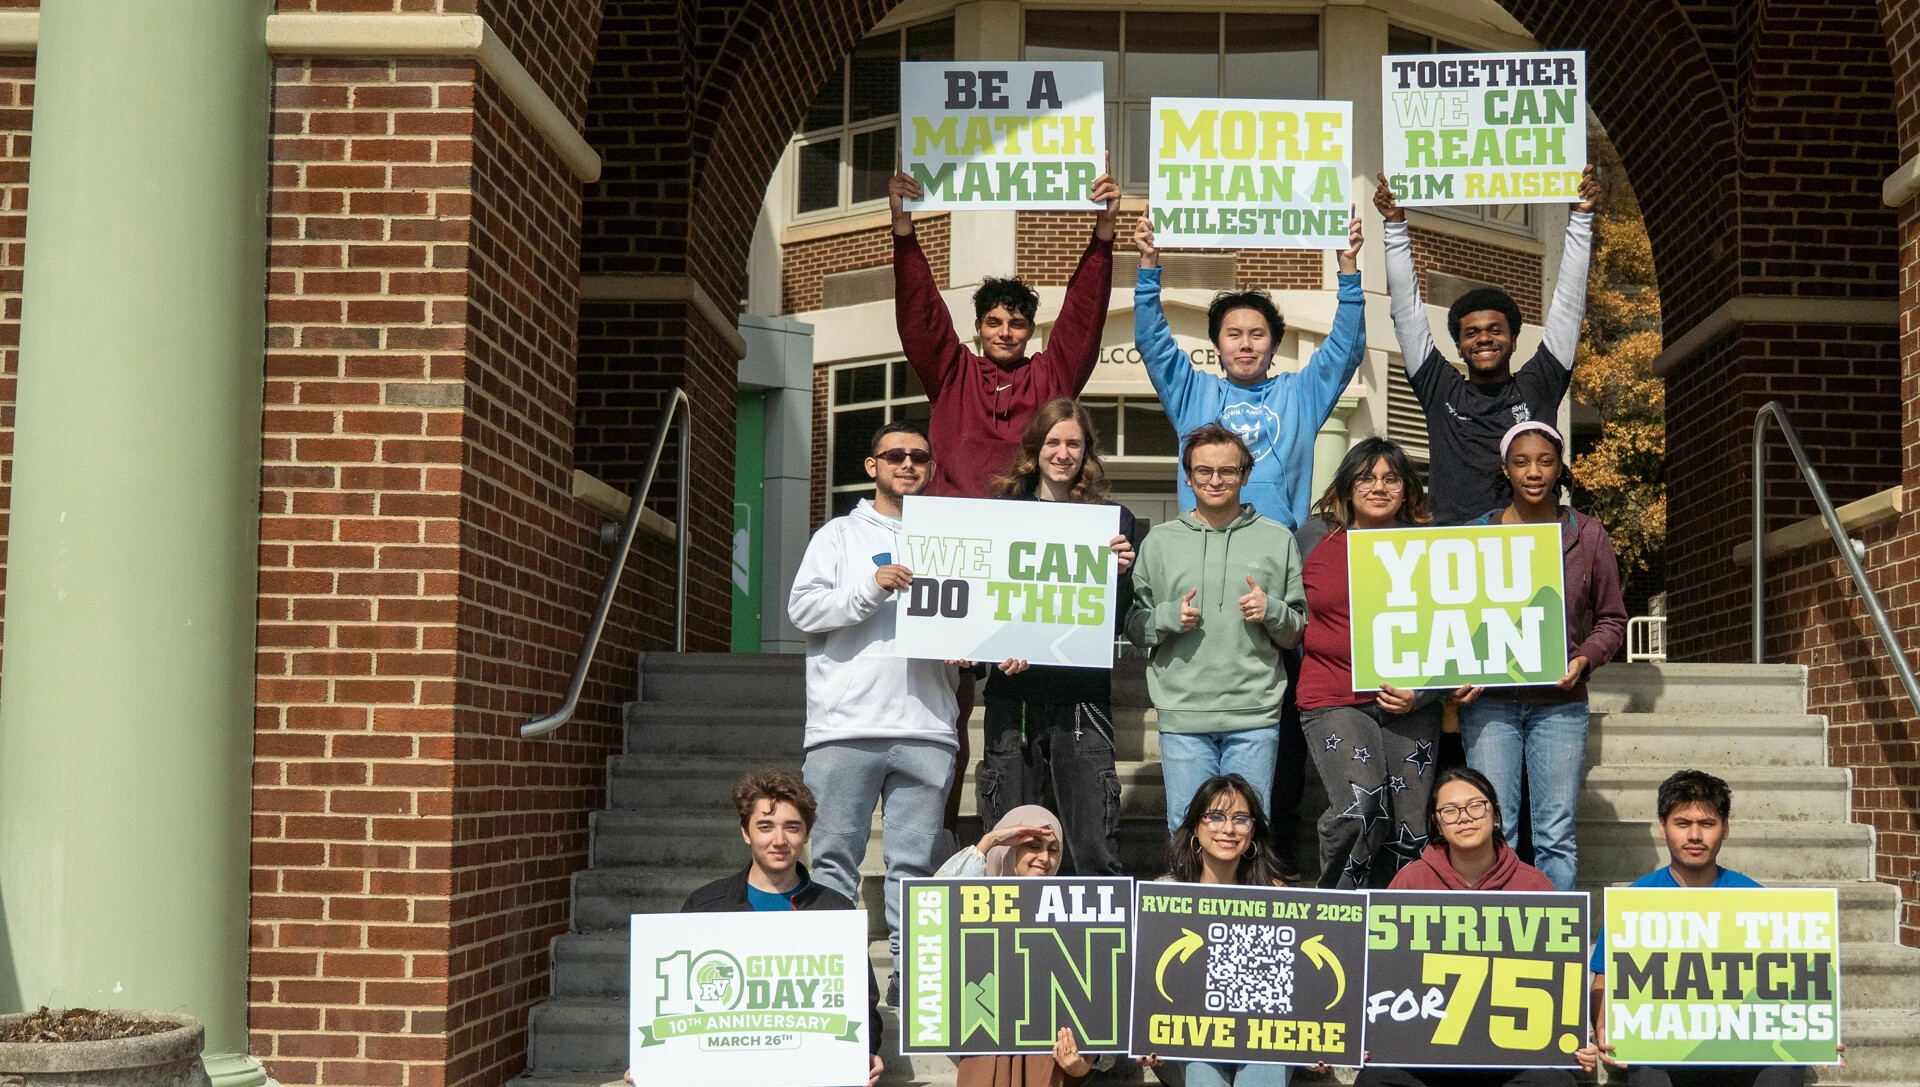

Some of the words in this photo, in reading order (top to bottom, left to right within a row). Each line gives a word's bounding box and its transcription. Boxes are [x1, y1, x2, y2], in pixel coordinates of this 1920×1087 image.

[944, 70, 1009, 109] BE
[1026, 70, 1063, 109] A
[1391, 58, 1578, 88] TOGETHER
[1391, 90, 1469, 128] WE
[1484, 88, 1577, 125] CAN
[912, 116, 1095, 156] MATCH
[1159, 109, 1343, 161] MORE
[1404, 127, 1566, 168] REACH
[910, 162, 1097, 202] MAKER
[1158, 164, 1295, 202] THAN
[1310, 166, 1344, 203] A
[1389, 172, 1454, 202] $1M
[1464, 171, 1583, 199] RAISED
[1152, 207, 1349, 236] MILESTONE
[907, 535, 992, 579] WE
[1008, 541, 1112, 585] CAN
[1373, 535, 1535, 607] YOU
[907, 577, 969, 619] DO
[987, 581, 1106, 626] THIS
[1372, 606, 1545, 678] CAN
[917, 890, 942, 925] 26
[960, 885, 1020, 922] BE
[1035, 885, 1125, 922] ALL
[1142, 895, 1193, 914] RVCC
[1198, 898, 1267, 918] GIVING
[1272, 901, 1311, 920] DAY
[1316, 904, 1363, 923] 2026
[1368, 905, 1580, 953] STRIVE
[1612, 911, 1721, 949] JOIN
[1735, 911, 1831, 949] THE
[746, 954, 844, 978] GIVING
[822, 978, 845, 992] 20
[1612, 952, 1832, 1000] MATCH
[700, 979, 730, 1000] RV
[746, 979, 820, 1010] DAY
[822, 994, 845, 1008] 26
[918, 935, 942, 1042] MARCH
[1366, 987, 1448, 1023] FOR
[1422, 953, 1583, 1054] 75!
[668, 1017, 701, 1034] 10TH
[706, 1014, 831, 1031] ANNIVERSARY
[708, 1035, 761, 1047] MARCH
[764, 1034, 793, 1046] 26TH
[1149, 1014, 1236, 1048] GIVE
[1247, 1018, 1346, 1053] HERE
[1612, 1003, 1834, 1041] MADNESS
